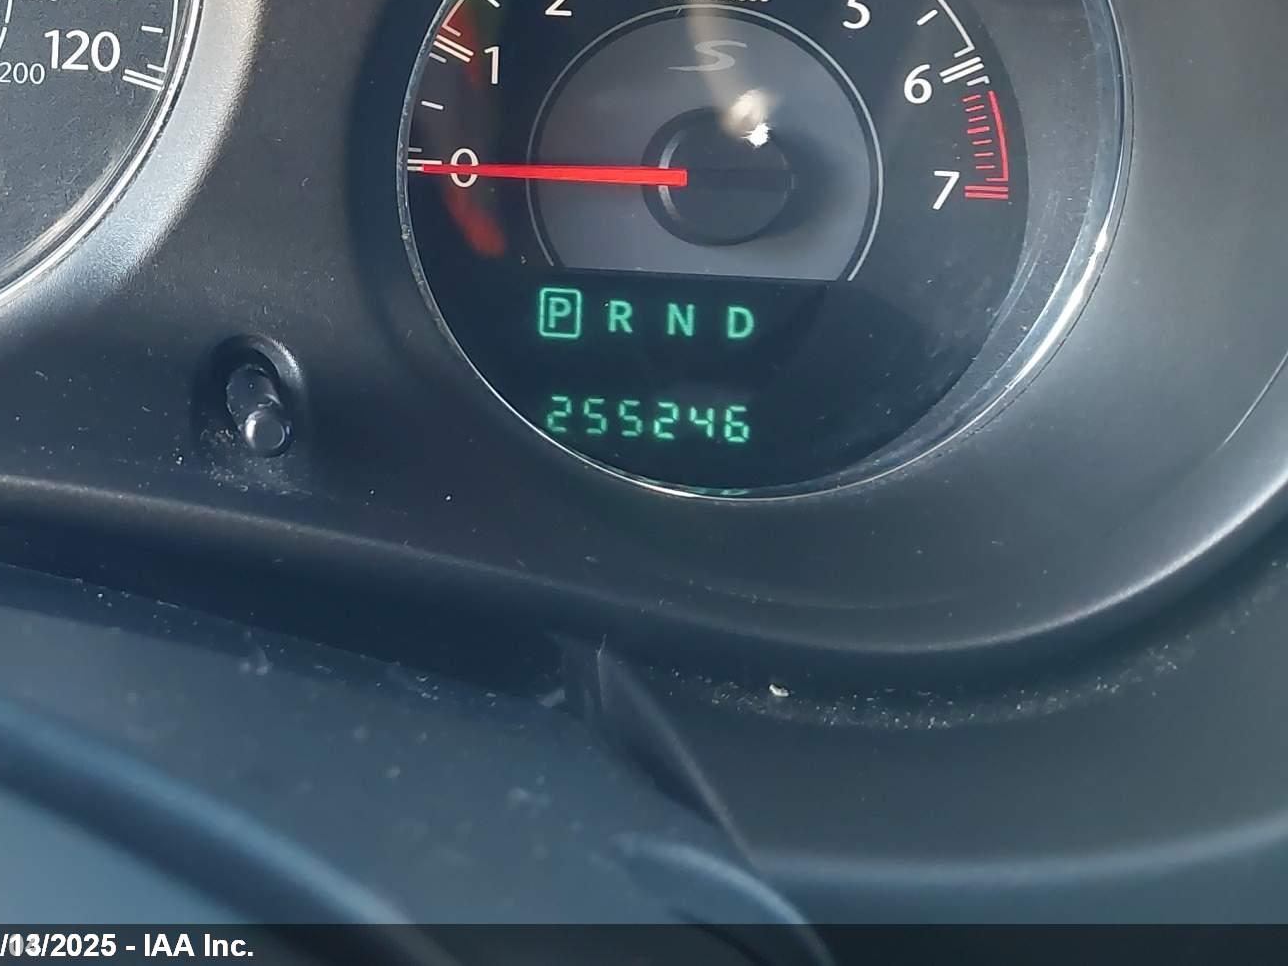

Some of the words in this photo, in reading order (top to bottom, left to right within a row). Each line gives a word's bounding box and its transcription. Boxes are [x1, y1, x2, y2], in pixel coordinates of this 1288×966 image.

[45, 31, 120, 71] 120
[484, 46, 501, 84] 1
[904, 65, 932, 103] 6
[449, 148, 479, 187] 0
[932, 172, 960, 210] 7
[548, 298, 572, 330] P
[609, 301, 632, 333] R
[668, 304, 693, 336] N
[728, 307, 754, 338] D
[547, 395, 750, 442] 255246
